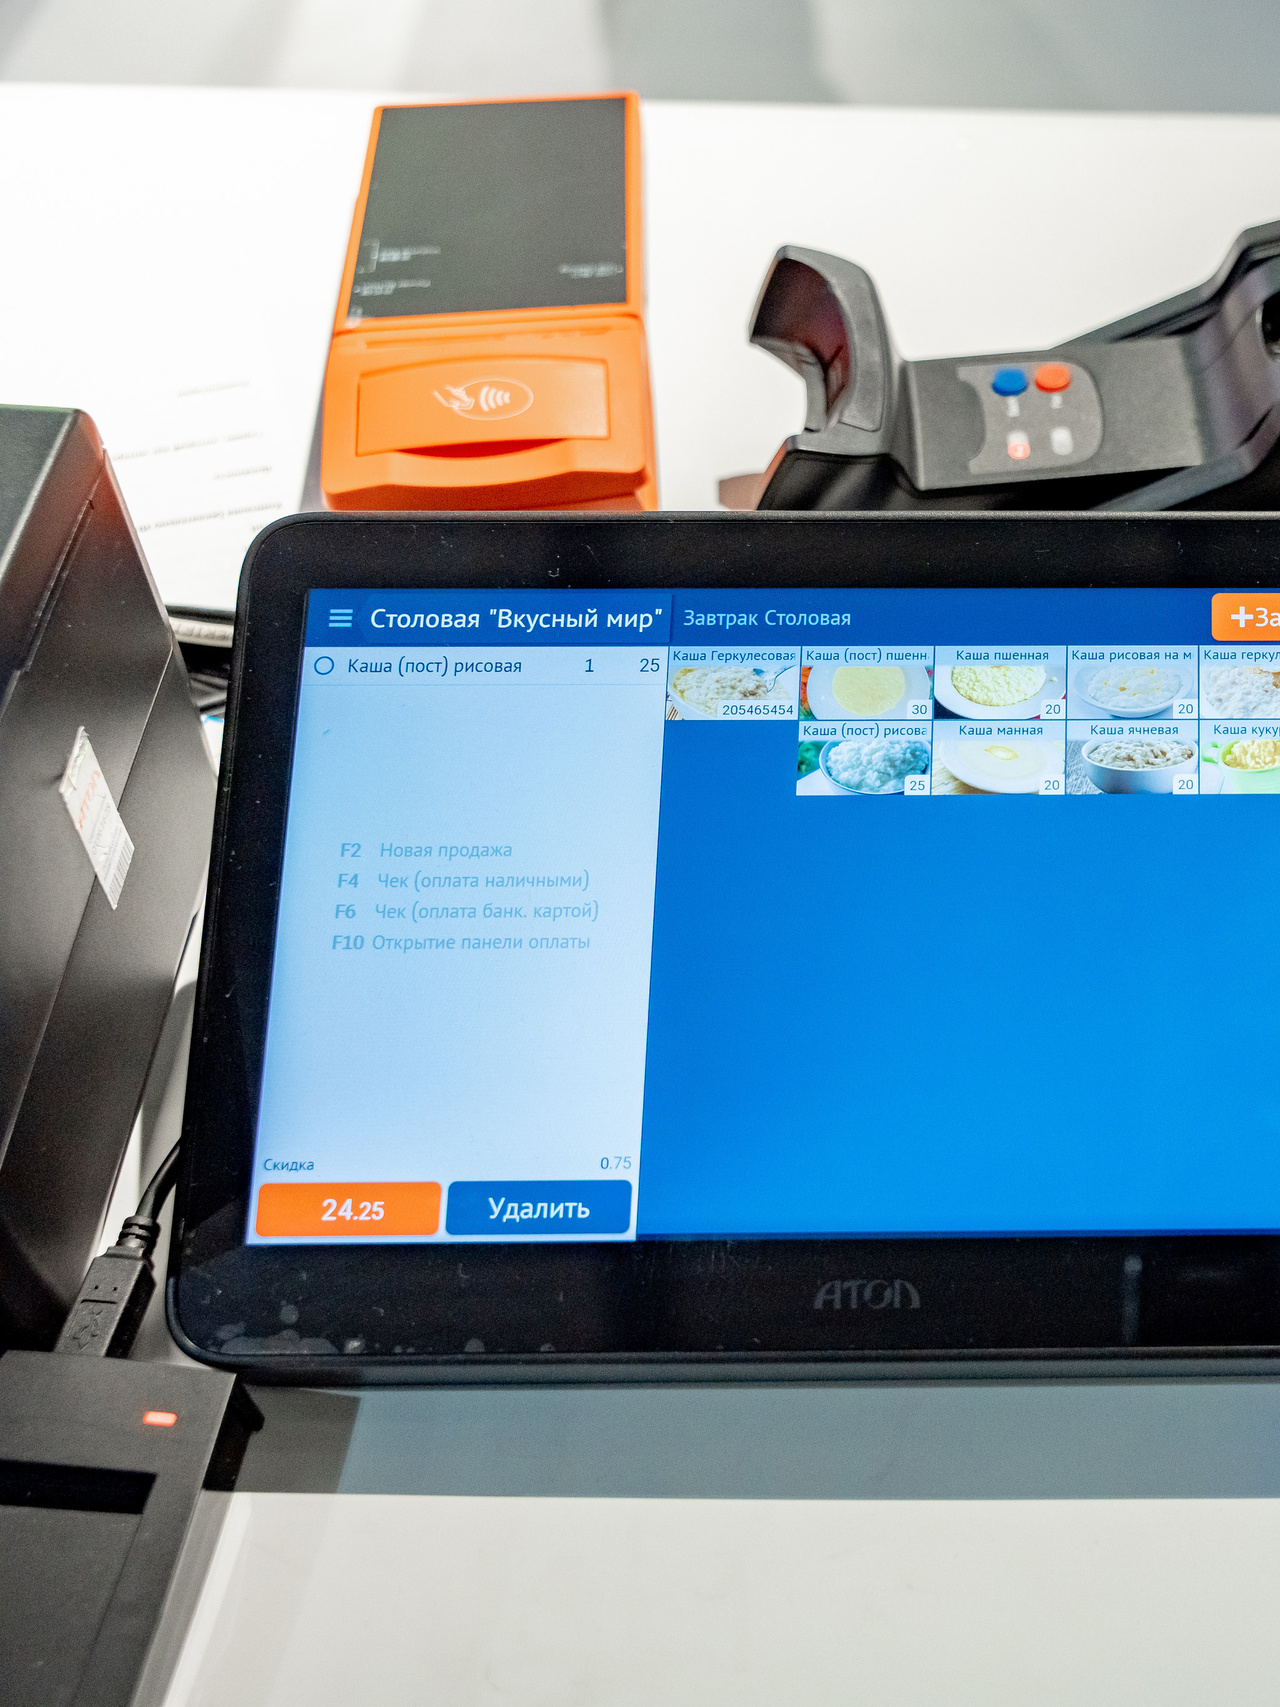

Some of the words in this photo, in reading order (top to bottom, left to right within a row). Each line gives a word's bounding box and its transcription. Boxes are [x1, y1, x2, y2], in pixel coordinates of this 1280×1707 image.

[370, 608, 480, 629] Столовая
[489, 608, 598, 633] "Вкусный
[607, 608, 663, 633] мир"
[683, 609, 759, 629] Завтрак
[764, 609, 851, 626] Столовая
[673, 651, 707, 661] Каша
[712, 651, 796, 664] Геркулесовая
[806, 651, 839, 661] Каша
[844, 648, 882, 664] (пост)
[886, 652, 930, 661] пшенн
[956, 650, 990, 661] Каша
[995, 651, 1049, 661] пшенная
[1071, 650, 1105, 661] Каша
[1110, 651, 1160, 664] рисовая
[1164, 651, 1179, 660] на
[1183, 652, 1194, 660] м
[1203, 649, 1237, 660] Каша
[348, 658, 393, 673] Каша
[398, 655, 448, 677] (пост)
[454, 660, 522, 677] рисовая
[584, 658, 595, 673] 1
[639, 658, 661, 673] 25
[722, 704, 794, 716] 205465454
[911, 704, 928, 715] 30
[1045, 703, 1061, 715] 20
[1178, 703, 1194, 715] 20
[803, 726, 836, 736] Каша
[841, 723, 880, 739] (пост)
[958, 725, 992, 736] Каша
[997, 726, 1044, 736] манная
[1090, 724, 1124, 735] Каша
[1128, 726, 1179, 736] ячневая
[1213, 724, 1247, 735] Каша
[909, 780, 926, 791] 25
[1044, 779, 1060, 791] 20
[1178, 779, 1194, 790] 20
[340, 842, 362, 858] F2
[380, 842, 433, 858] Новая
[438, 844, 513, 862] продажа
[337, 873, 359, 889] F4
[378, 873, 409, 888] Чек
[414, 869, 479, 893] (оплата
[485, 869, 590, 892] наличными)
[335, 904, 356, 919] F6
[375, 904, 407, 919] Чек
[412, 900, 477, 923] (оплата
[483, 902, 527, 919] банк.
[533, 899, 600, 923] картой)
[332, 935, 365, 950] F10
[372, 934, 456, 954] Открытие
[461, 936, 523, 950] панели
[529, 936, 590, 950] оплаты
[263, 1158, 315, 1173] Скидка
[600, 1156, 633, 1170] 0.75
[321, 1198, 385, 1222] 24.25
[488, 1197, 590, 1223] Удалить
